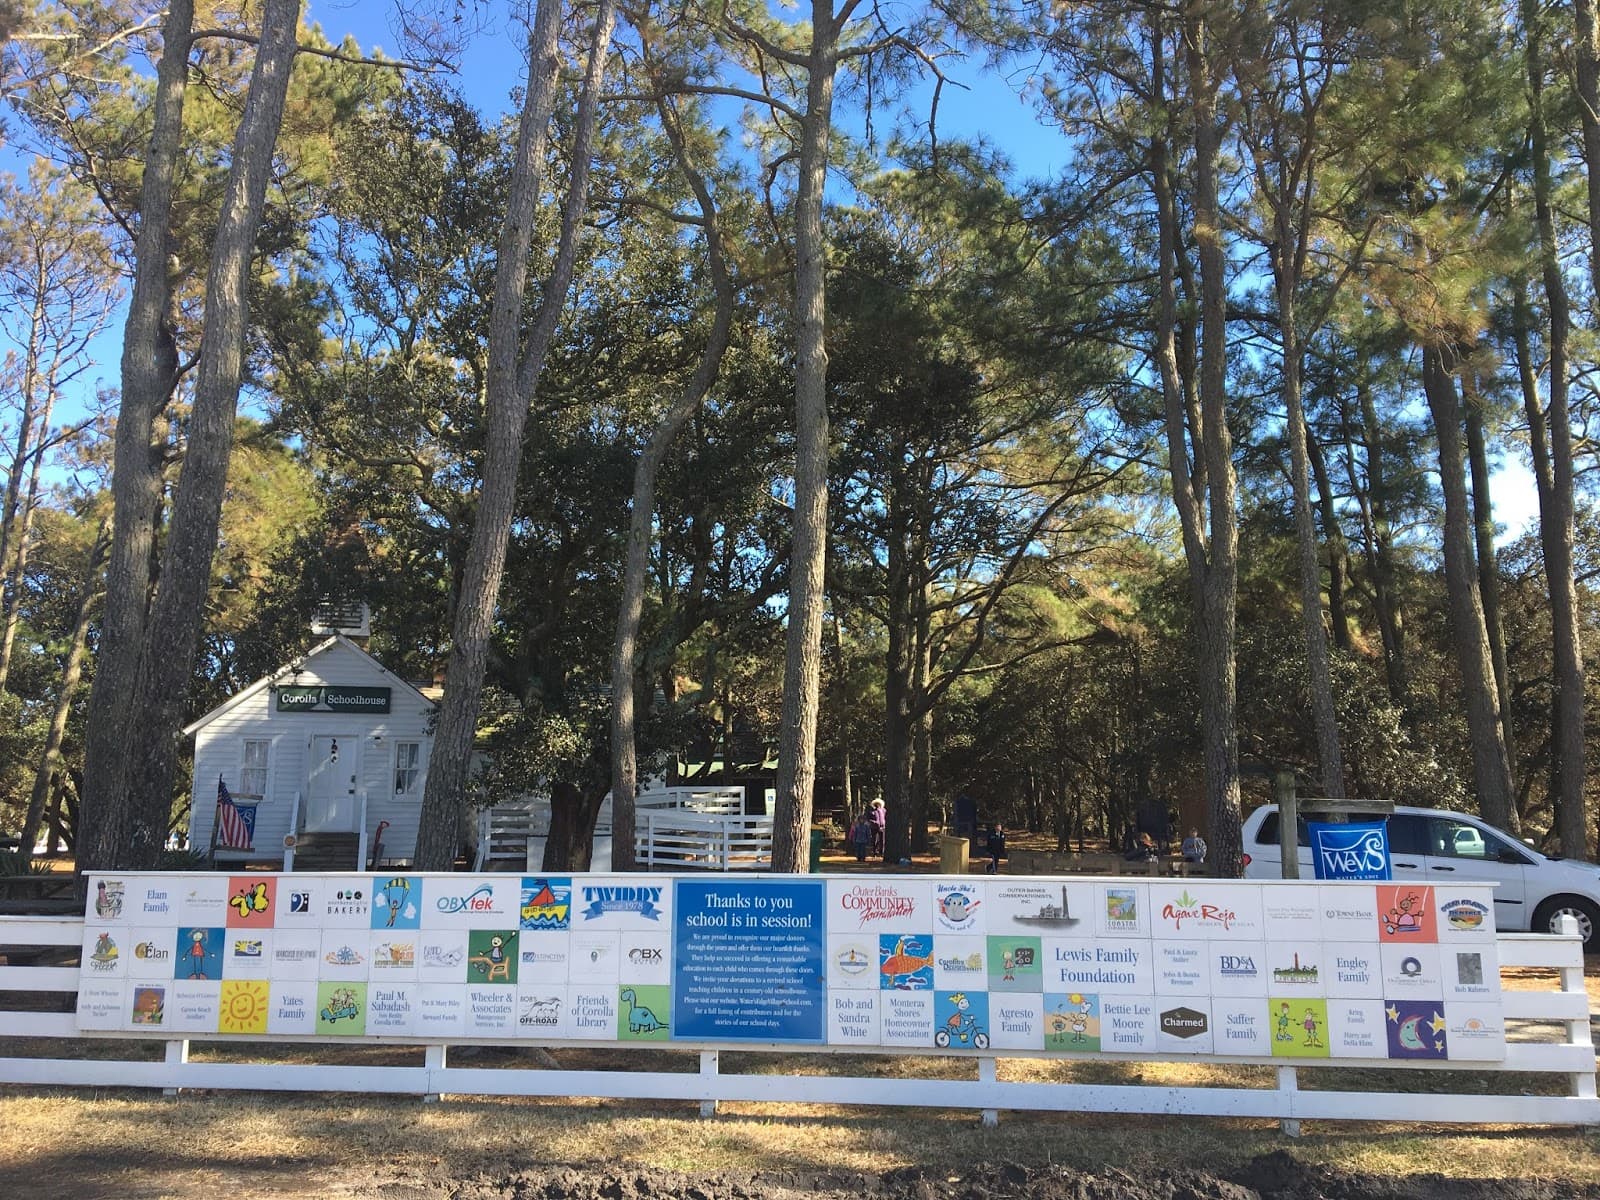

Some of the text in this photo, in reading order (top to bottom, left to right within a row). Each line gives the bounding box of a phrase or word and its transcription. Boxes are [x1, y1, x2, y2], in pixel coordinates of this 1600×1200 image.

[281, 694, 386, 705] Corolla Schoolhouse
[852, 885, 898, 896] Outer Banks
[937, 884, 956, 892] Uncle
[147, 890, 168, 900] Elam
[582, 887, 664, 902] TWIDDY
[601, 902, 624, 910] Since
[705, 893, 792, 912] Thanks to you
[842, 894, 914, 910] COMMUNITY
[143, 902, 169, 914] Family
[686, 912, 812, 928] school is in session!
[1162, 904, 1236, 930] Agave Roja
[628, 948, 662, 959] OBX
[1056, 948, 1139, 966] Lewis Family
[1220, 956, 1256, 969] BD&A
[1336, 957, 1368, 970] Engley
[1060, 968, 1135, 984] Foundation
[1338, 971, 1370, 984] Family
[282, 996, 304, 1005] Yates
[376, 991, 407, 1001] Paul M.
[471, 992, 512, 1003] Wheeler &
[577, 995, 609, 1005] Friends
[371, 1001, 410, 1012] Sabadash
[471, 1004, 512, 1014] Associates
[835, 998, 873, 1009] Bob and
[572, 1007, 614, 1016] of Corolla
[894, 1008, 920, 1017] Shores
[999, 1009, 1034, 1021] Agresto
[1104, 1004, 1150, 1015] Bettie Lee
[278, 1008, 306, 1023] Family
[838, 1013, 870, 1023] Sandra
[1227, 1014, 1255, 1024] Saffer
[576, 1017, 608, 1030] Library
[884, 1018, 930, 1028] Homeowner
[1112, 1018, 1144, 1029] Moore
[1163, 1017, 1204, 1027] Charmed
[841, 1026, 868, 1037] White
[886, 1028, 929, 1038] Association
[1002, 1022, 1032, 1036] Family
[1113, 1032, 1144, 1046] Family
[1226, 1029, 1258, 1041] Family
